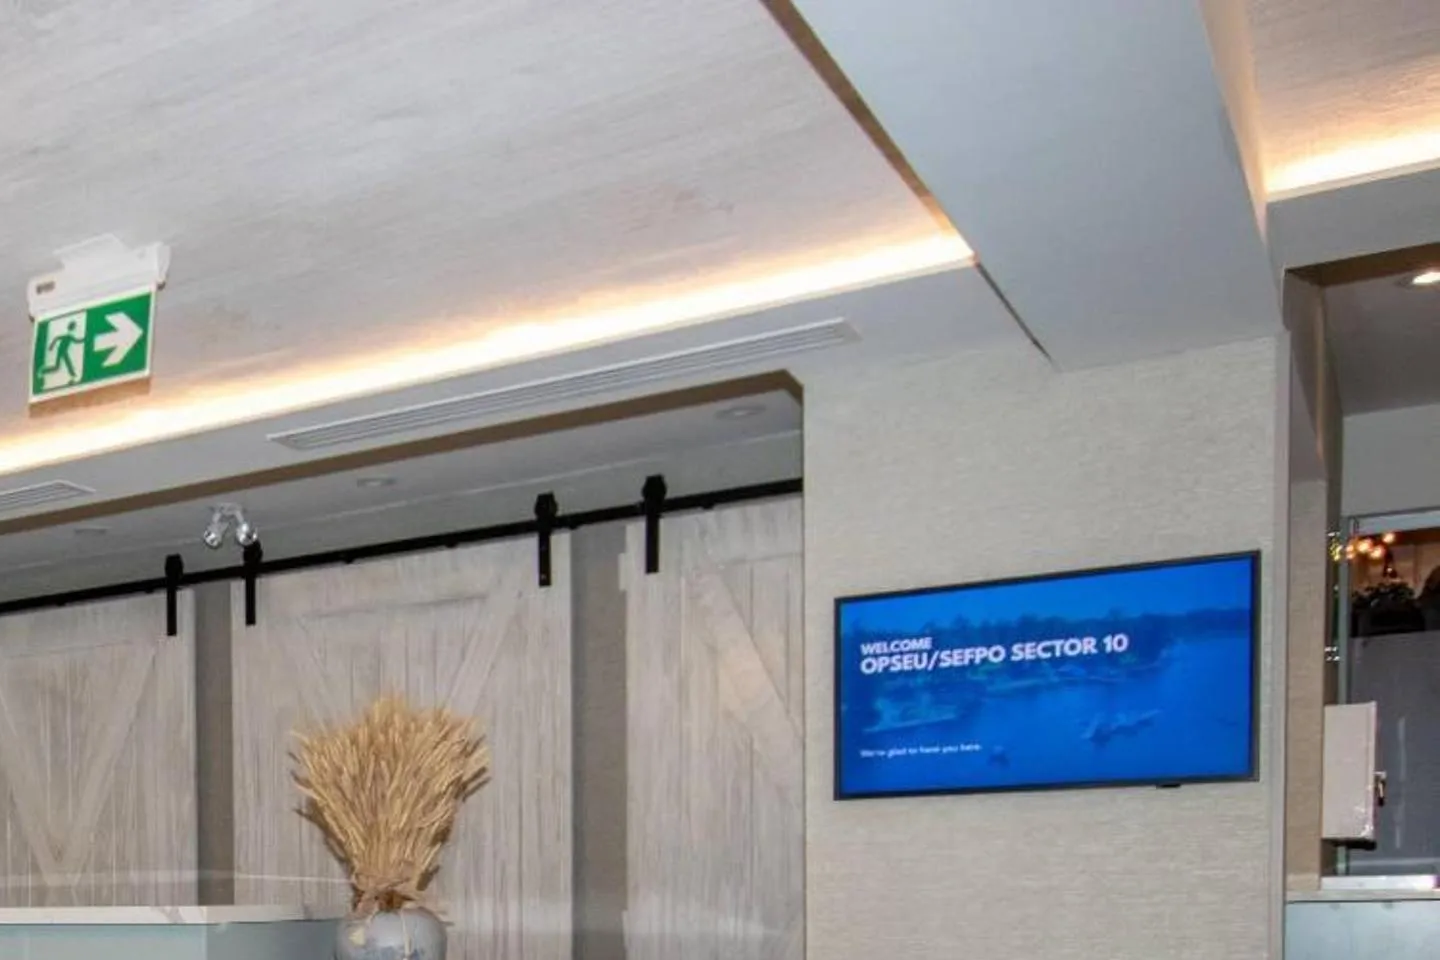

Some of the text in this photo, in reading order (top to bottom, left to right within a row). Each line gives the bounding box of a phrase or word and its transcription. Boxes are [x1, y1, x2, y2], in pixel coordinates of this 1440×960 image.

[860, 636, 933, 655] WELCOME
[860, 633, 1129, 674] OPSEU/SEFPO SECTOR 10
